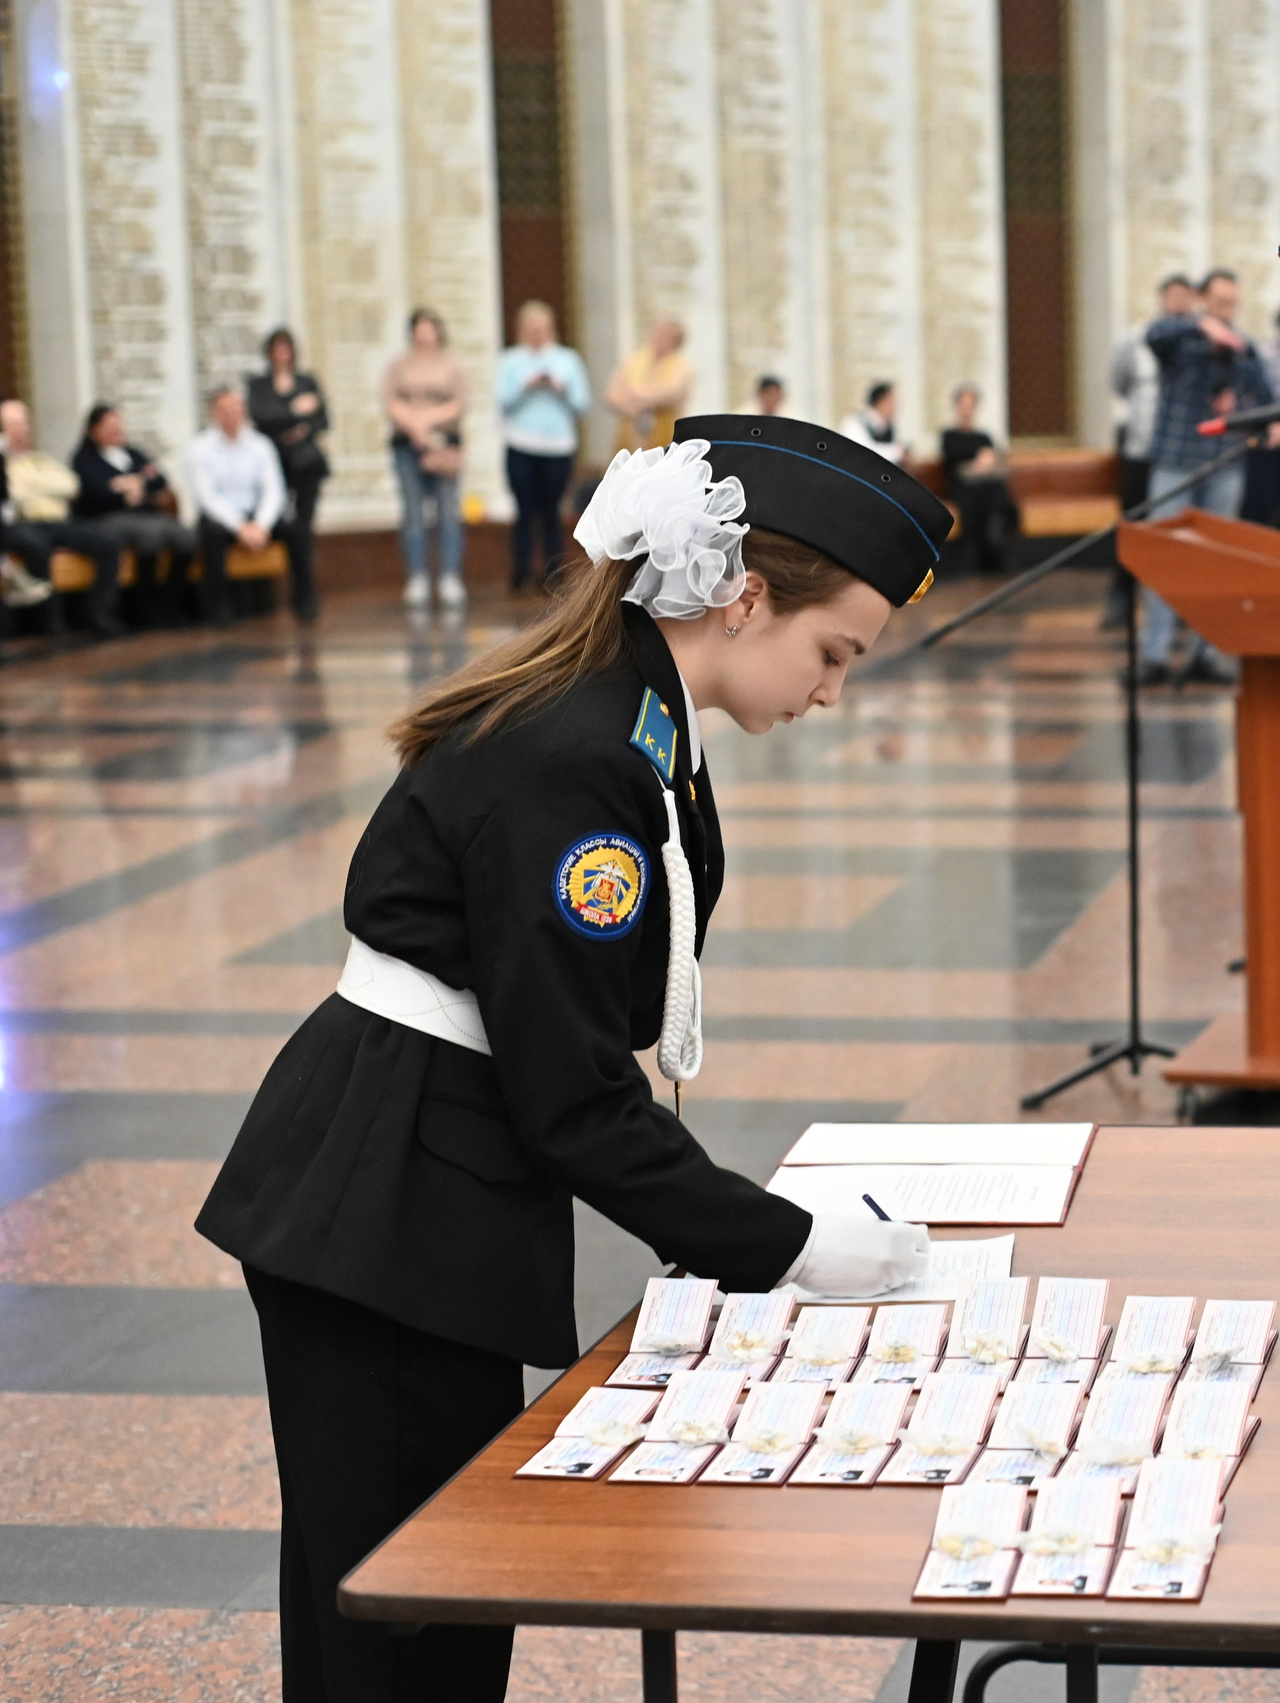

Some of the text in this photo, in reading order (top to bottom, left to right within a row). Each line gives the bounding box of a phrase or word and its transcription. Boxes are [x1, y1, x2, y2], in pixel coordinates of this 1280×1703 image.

[559, 854, 577, 900] КАДЕТСКИЕ
[575, 837, 607, 856] КЛАССЫ
[610, 837, 641, 859] АВИАЦИИ
